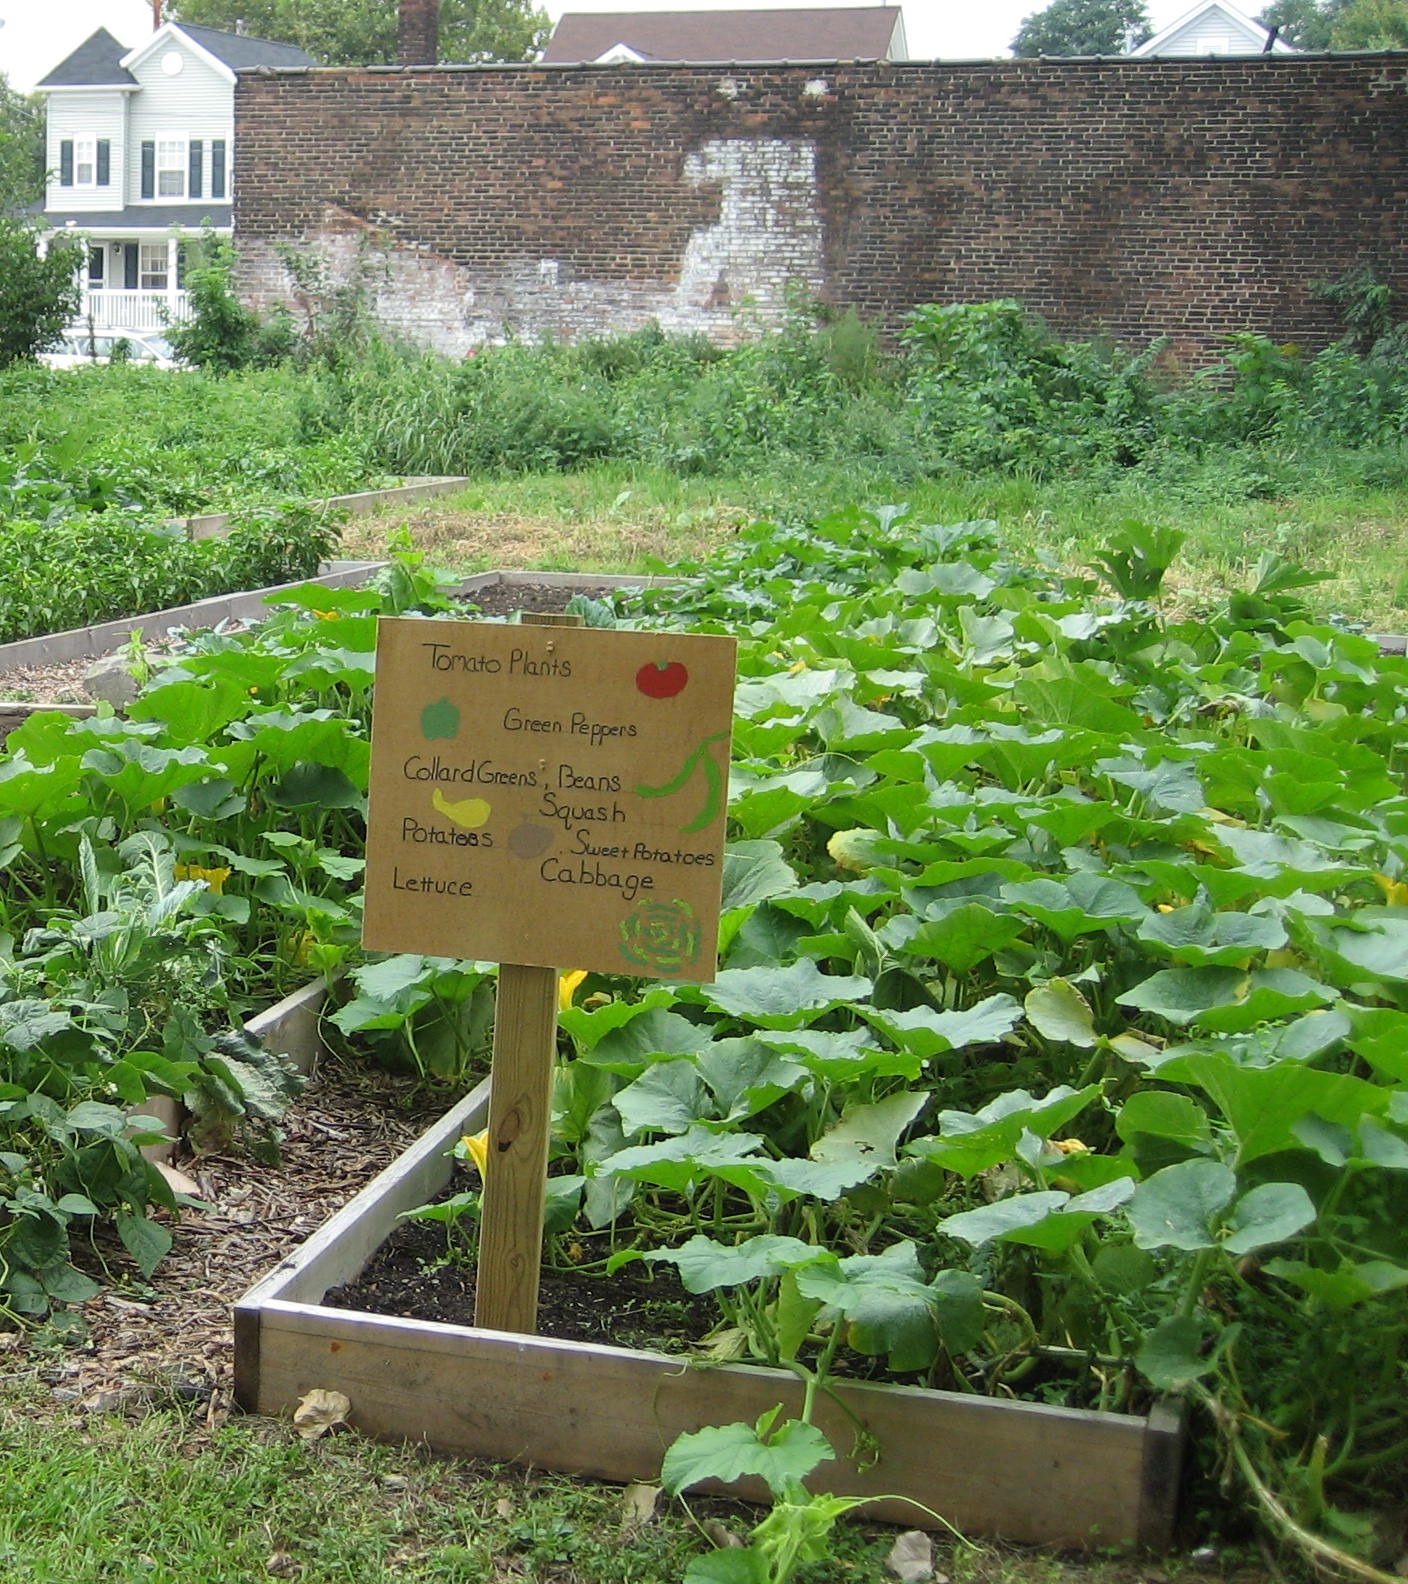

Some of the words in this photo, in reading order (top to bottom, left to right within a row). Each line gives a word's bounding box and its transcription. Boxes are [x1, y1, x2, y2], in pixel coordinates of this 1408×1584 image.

[421, 643, 502, 674] Tomato
[508, 648, 572, 678] Plants
[503, 707, 562, 733] Green
[570, 711, 638, 746] Peppers
[403, 755, 475, 783] Collard
[558, 764, 622, 792] Beans
[539, 792, 626, 831] Squash
[570, 828, 631, 859] Sweet
[633, 842, 716, 867] Potatoes
[393, 866, 473, 897] Lettuce
[540, 857, 655, 901] Cabbage
